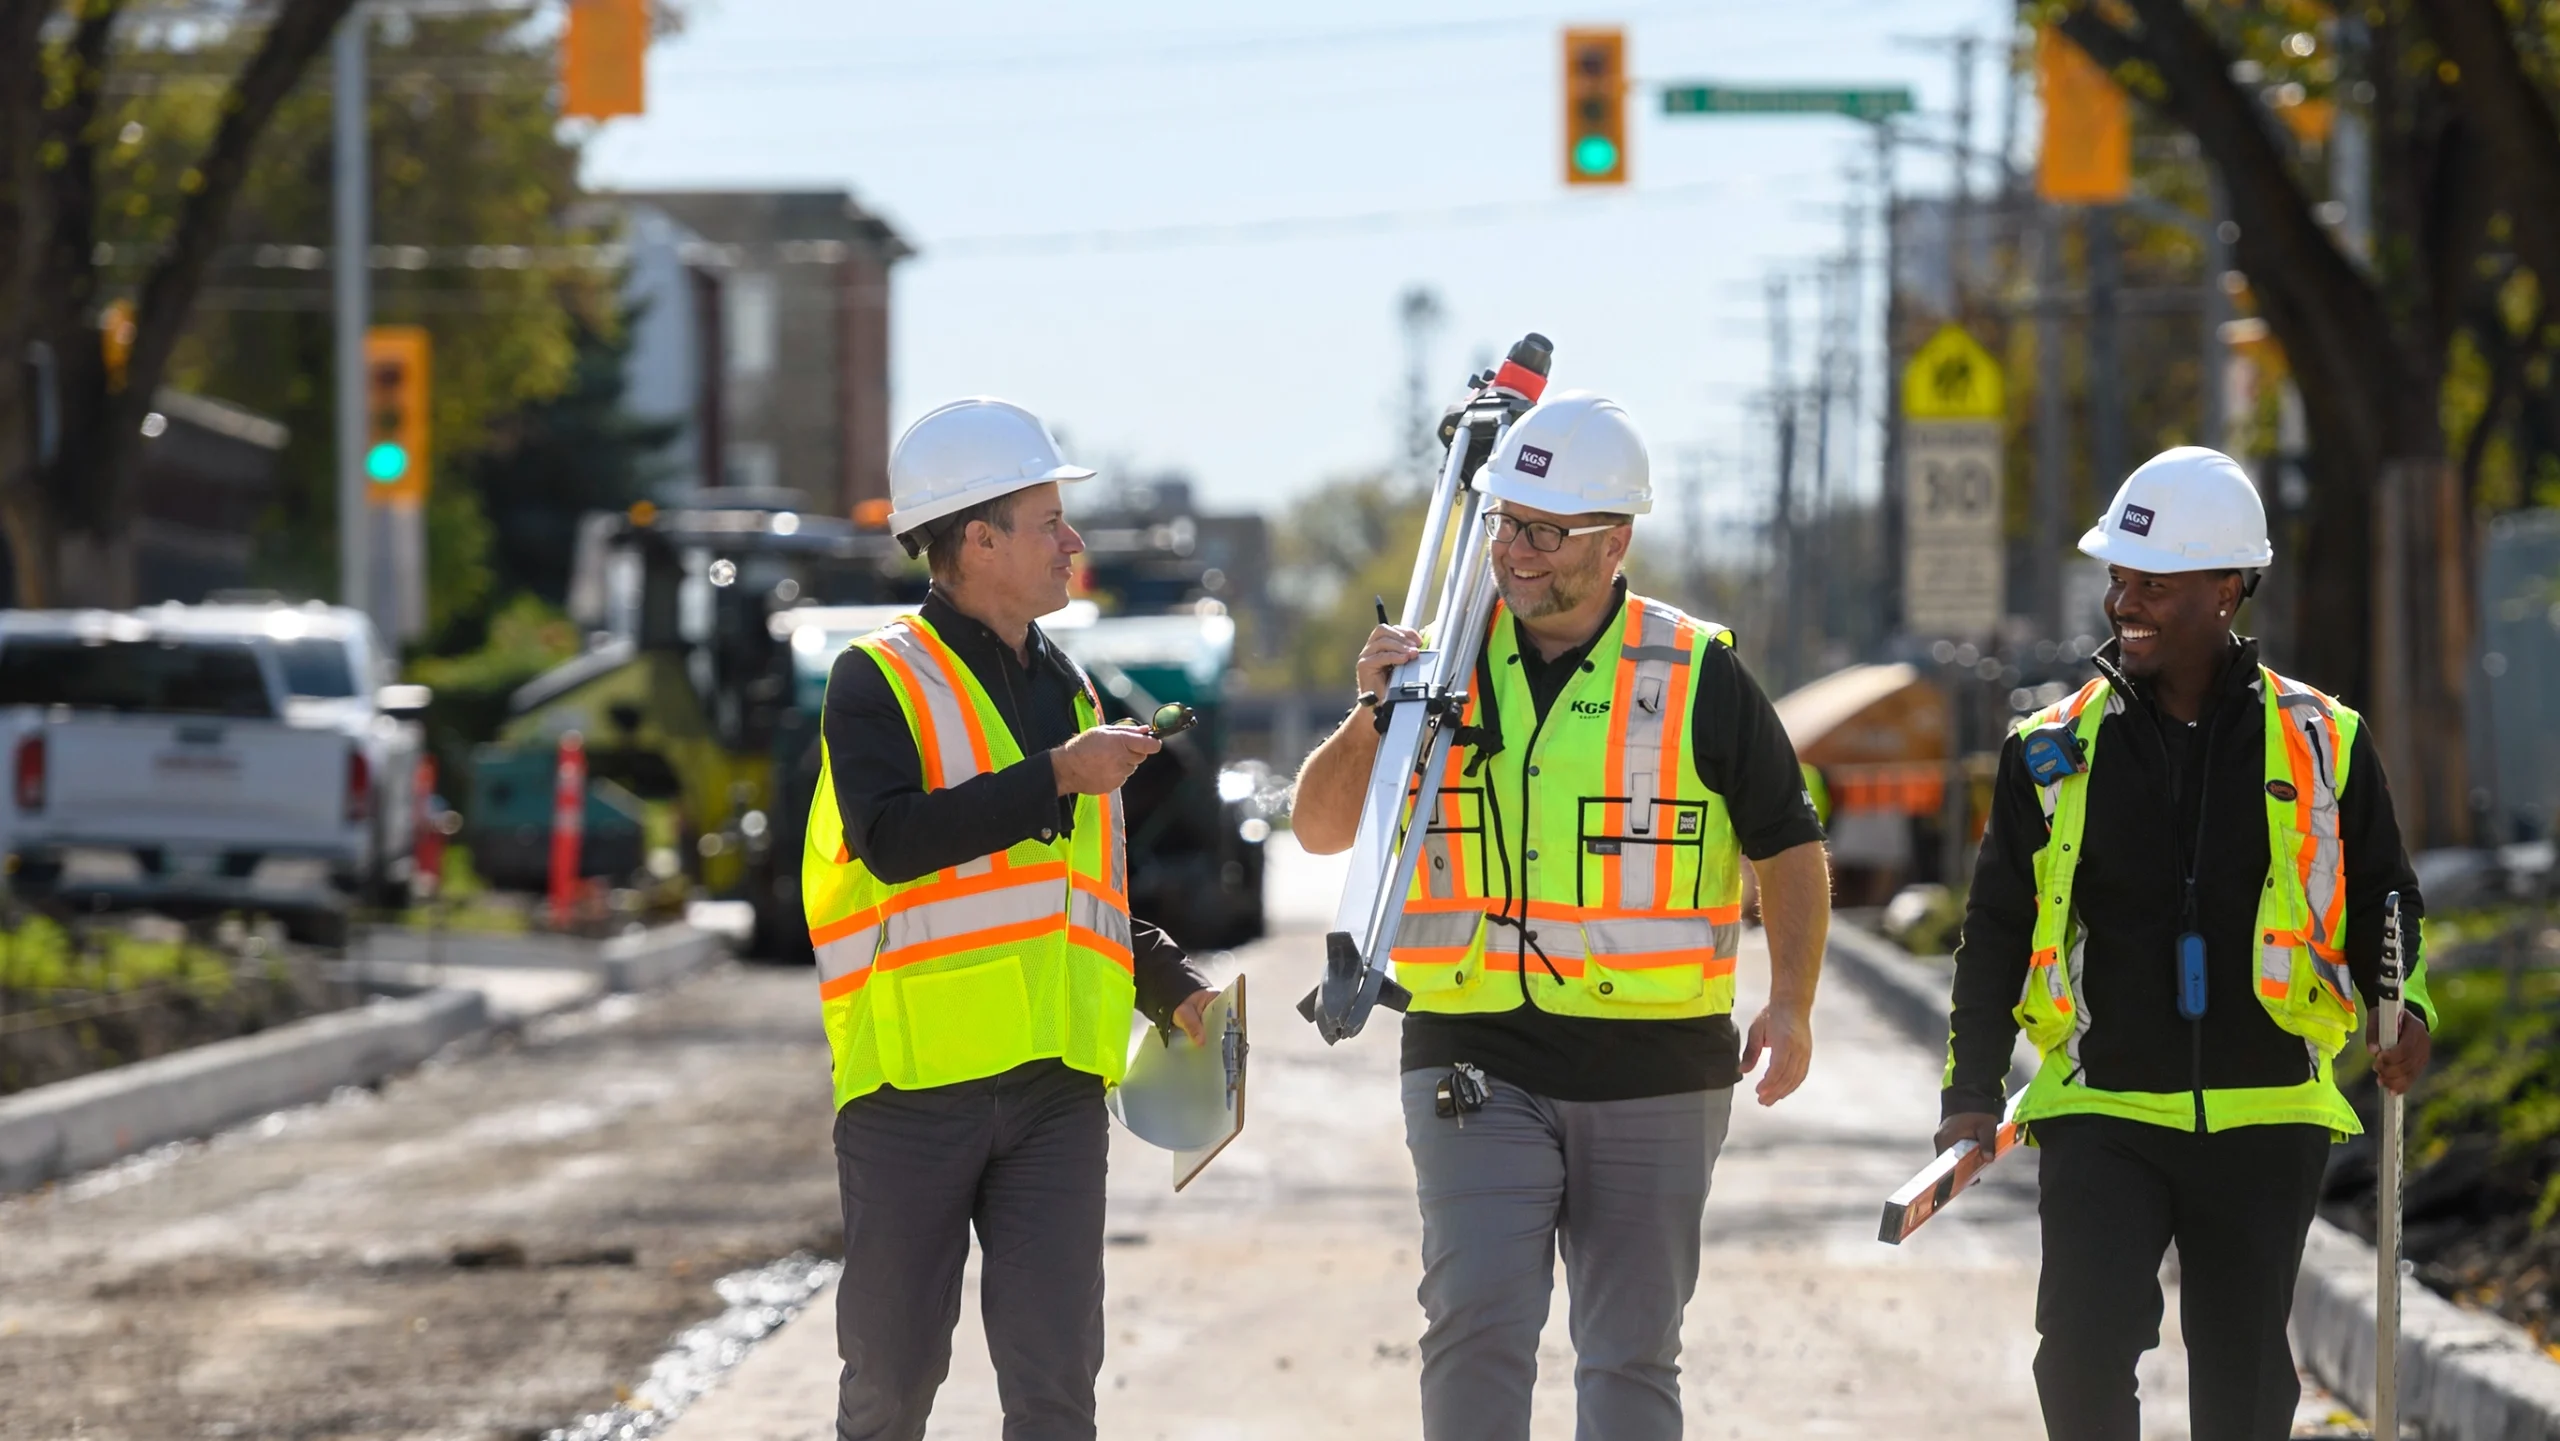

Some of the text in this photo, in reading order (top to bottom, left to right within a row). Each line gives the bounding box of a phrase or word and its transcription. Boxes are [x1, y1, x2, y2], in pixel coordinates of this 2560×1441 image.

[1521, 451, 1547, 467] KGS
[2125, 510, 2149, 525] KGS
[1571, 700, 1611, 714] KGS
